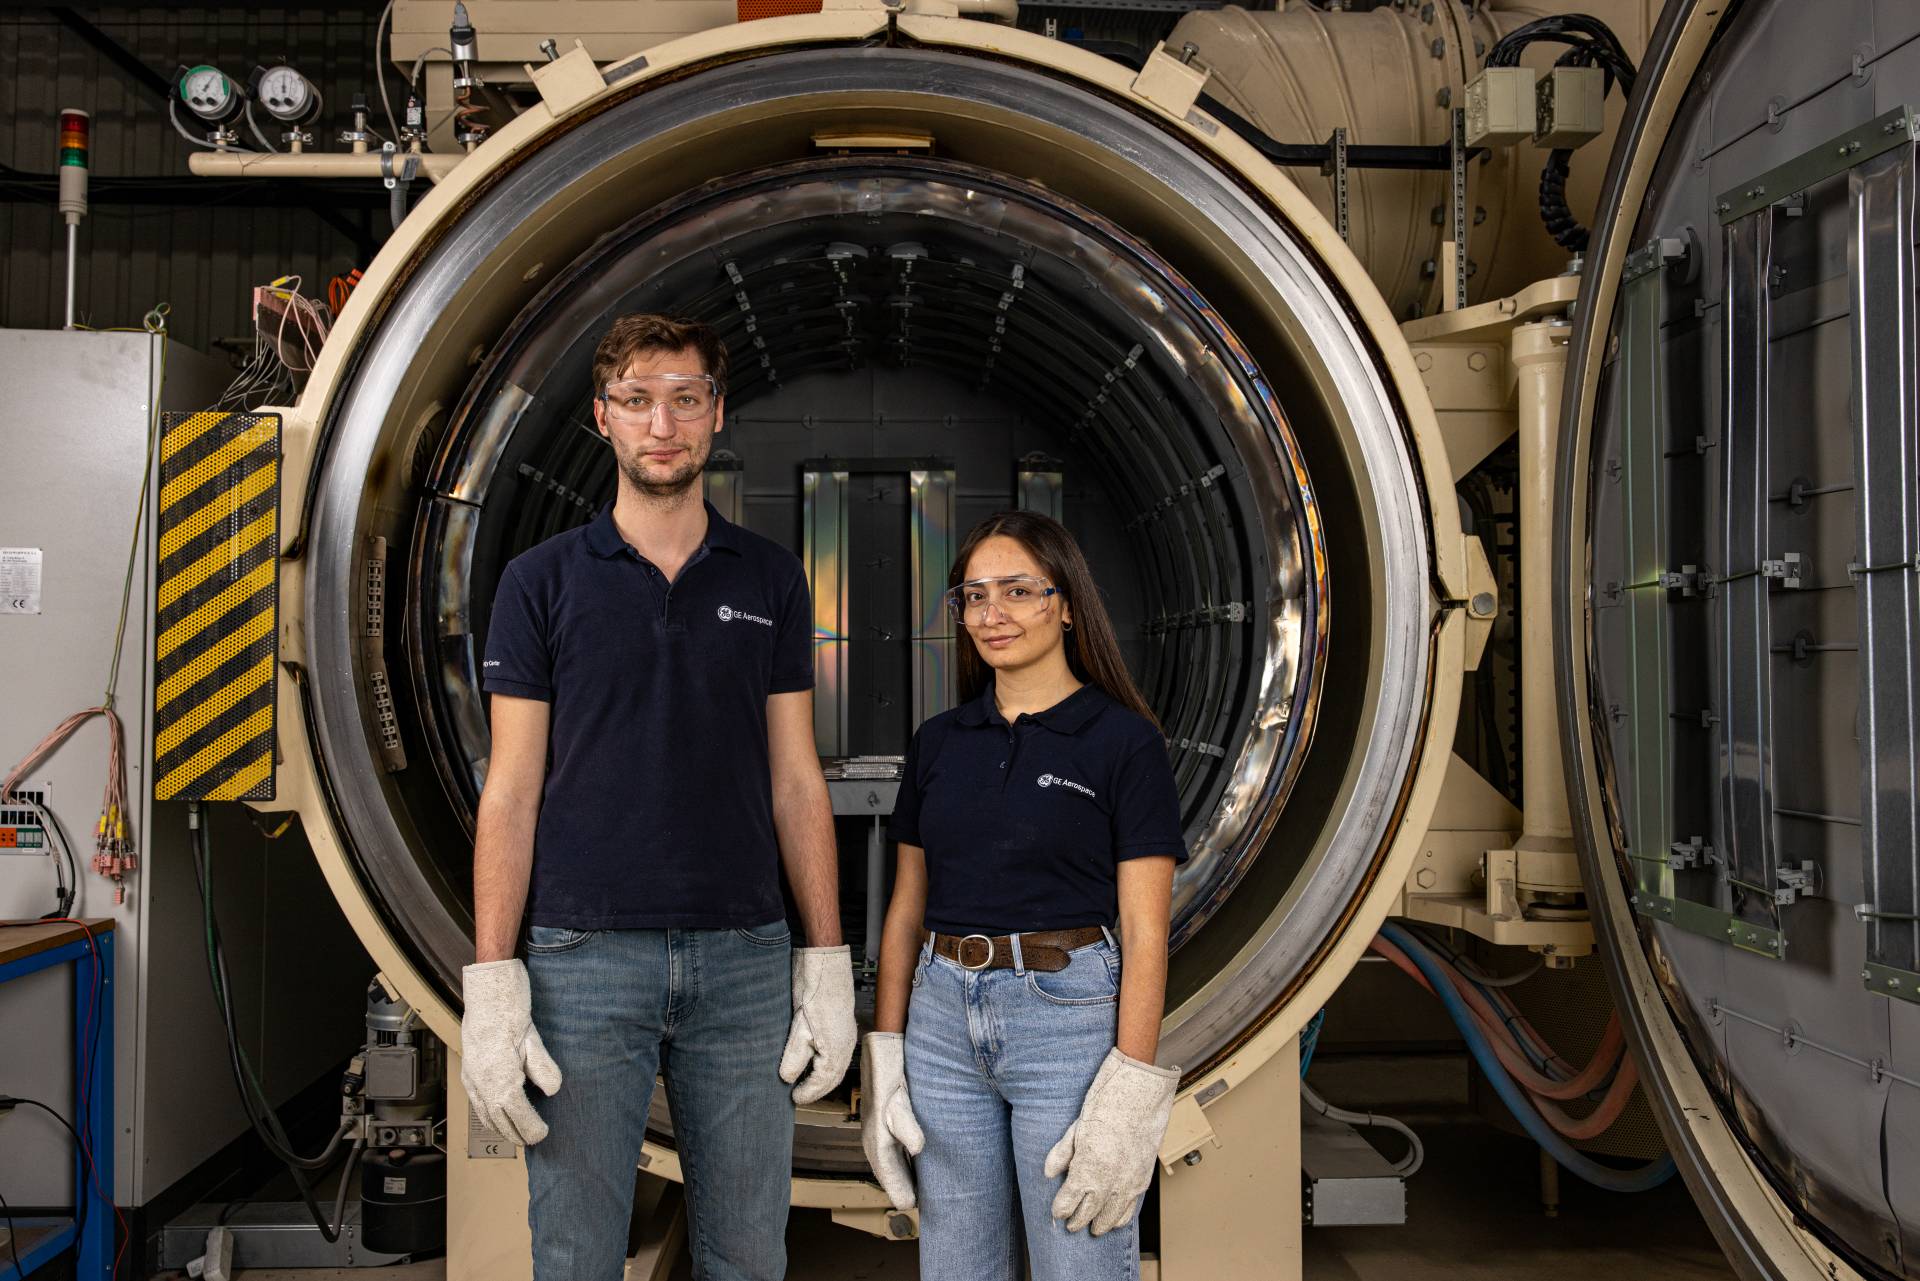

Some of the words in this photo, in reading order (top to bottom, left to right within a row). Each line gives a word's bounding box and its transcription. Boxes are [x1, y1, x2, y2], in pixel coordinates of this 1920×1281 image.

[733, 610, 742, 619] GE
[743, 612, 773, 626] Aerospace
[1053, 777, 1062, 785] GE
[1062, 779, 1096, 798] Aerospace
